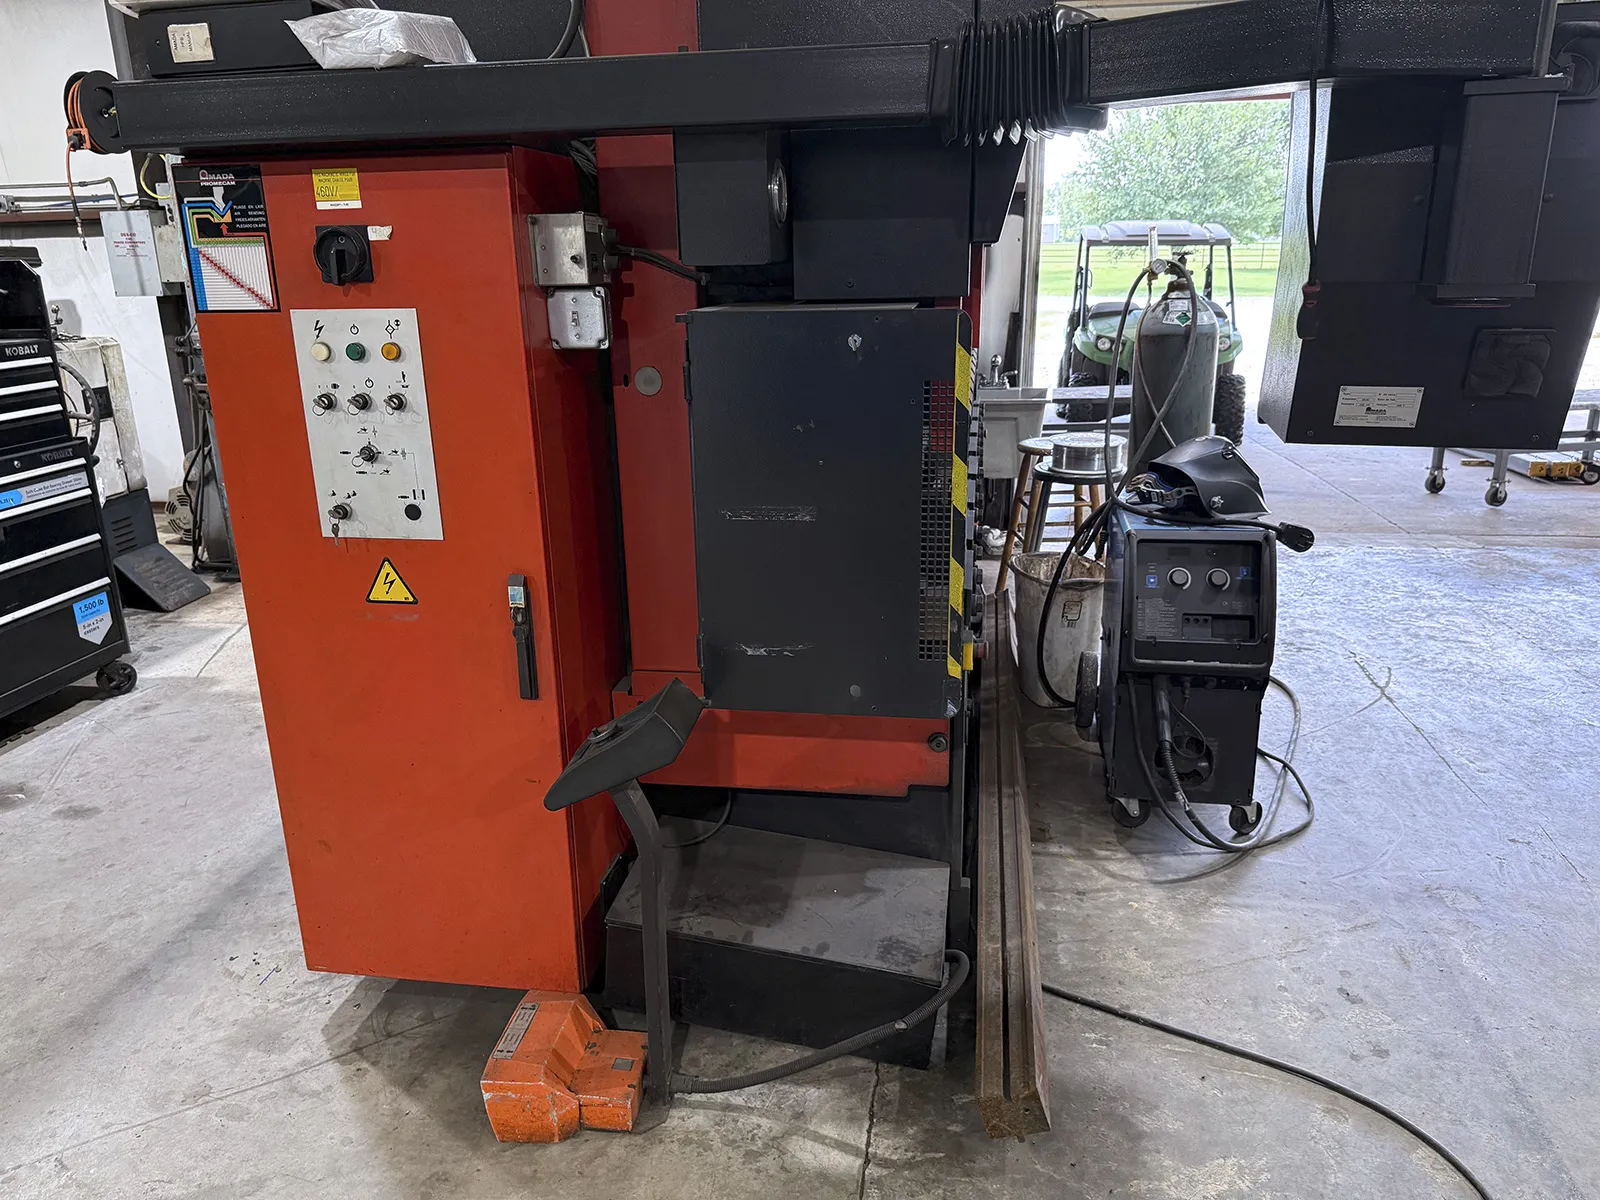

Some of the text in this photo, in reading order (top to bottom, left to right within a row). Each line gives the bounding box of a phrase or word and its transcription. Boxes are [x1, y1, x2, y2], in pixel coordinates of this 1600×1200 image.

[200, 170, 235, 180] AMADA
[5, 344, 39, 356] KOBALT
[79, 600, 96, 614] 1,500
